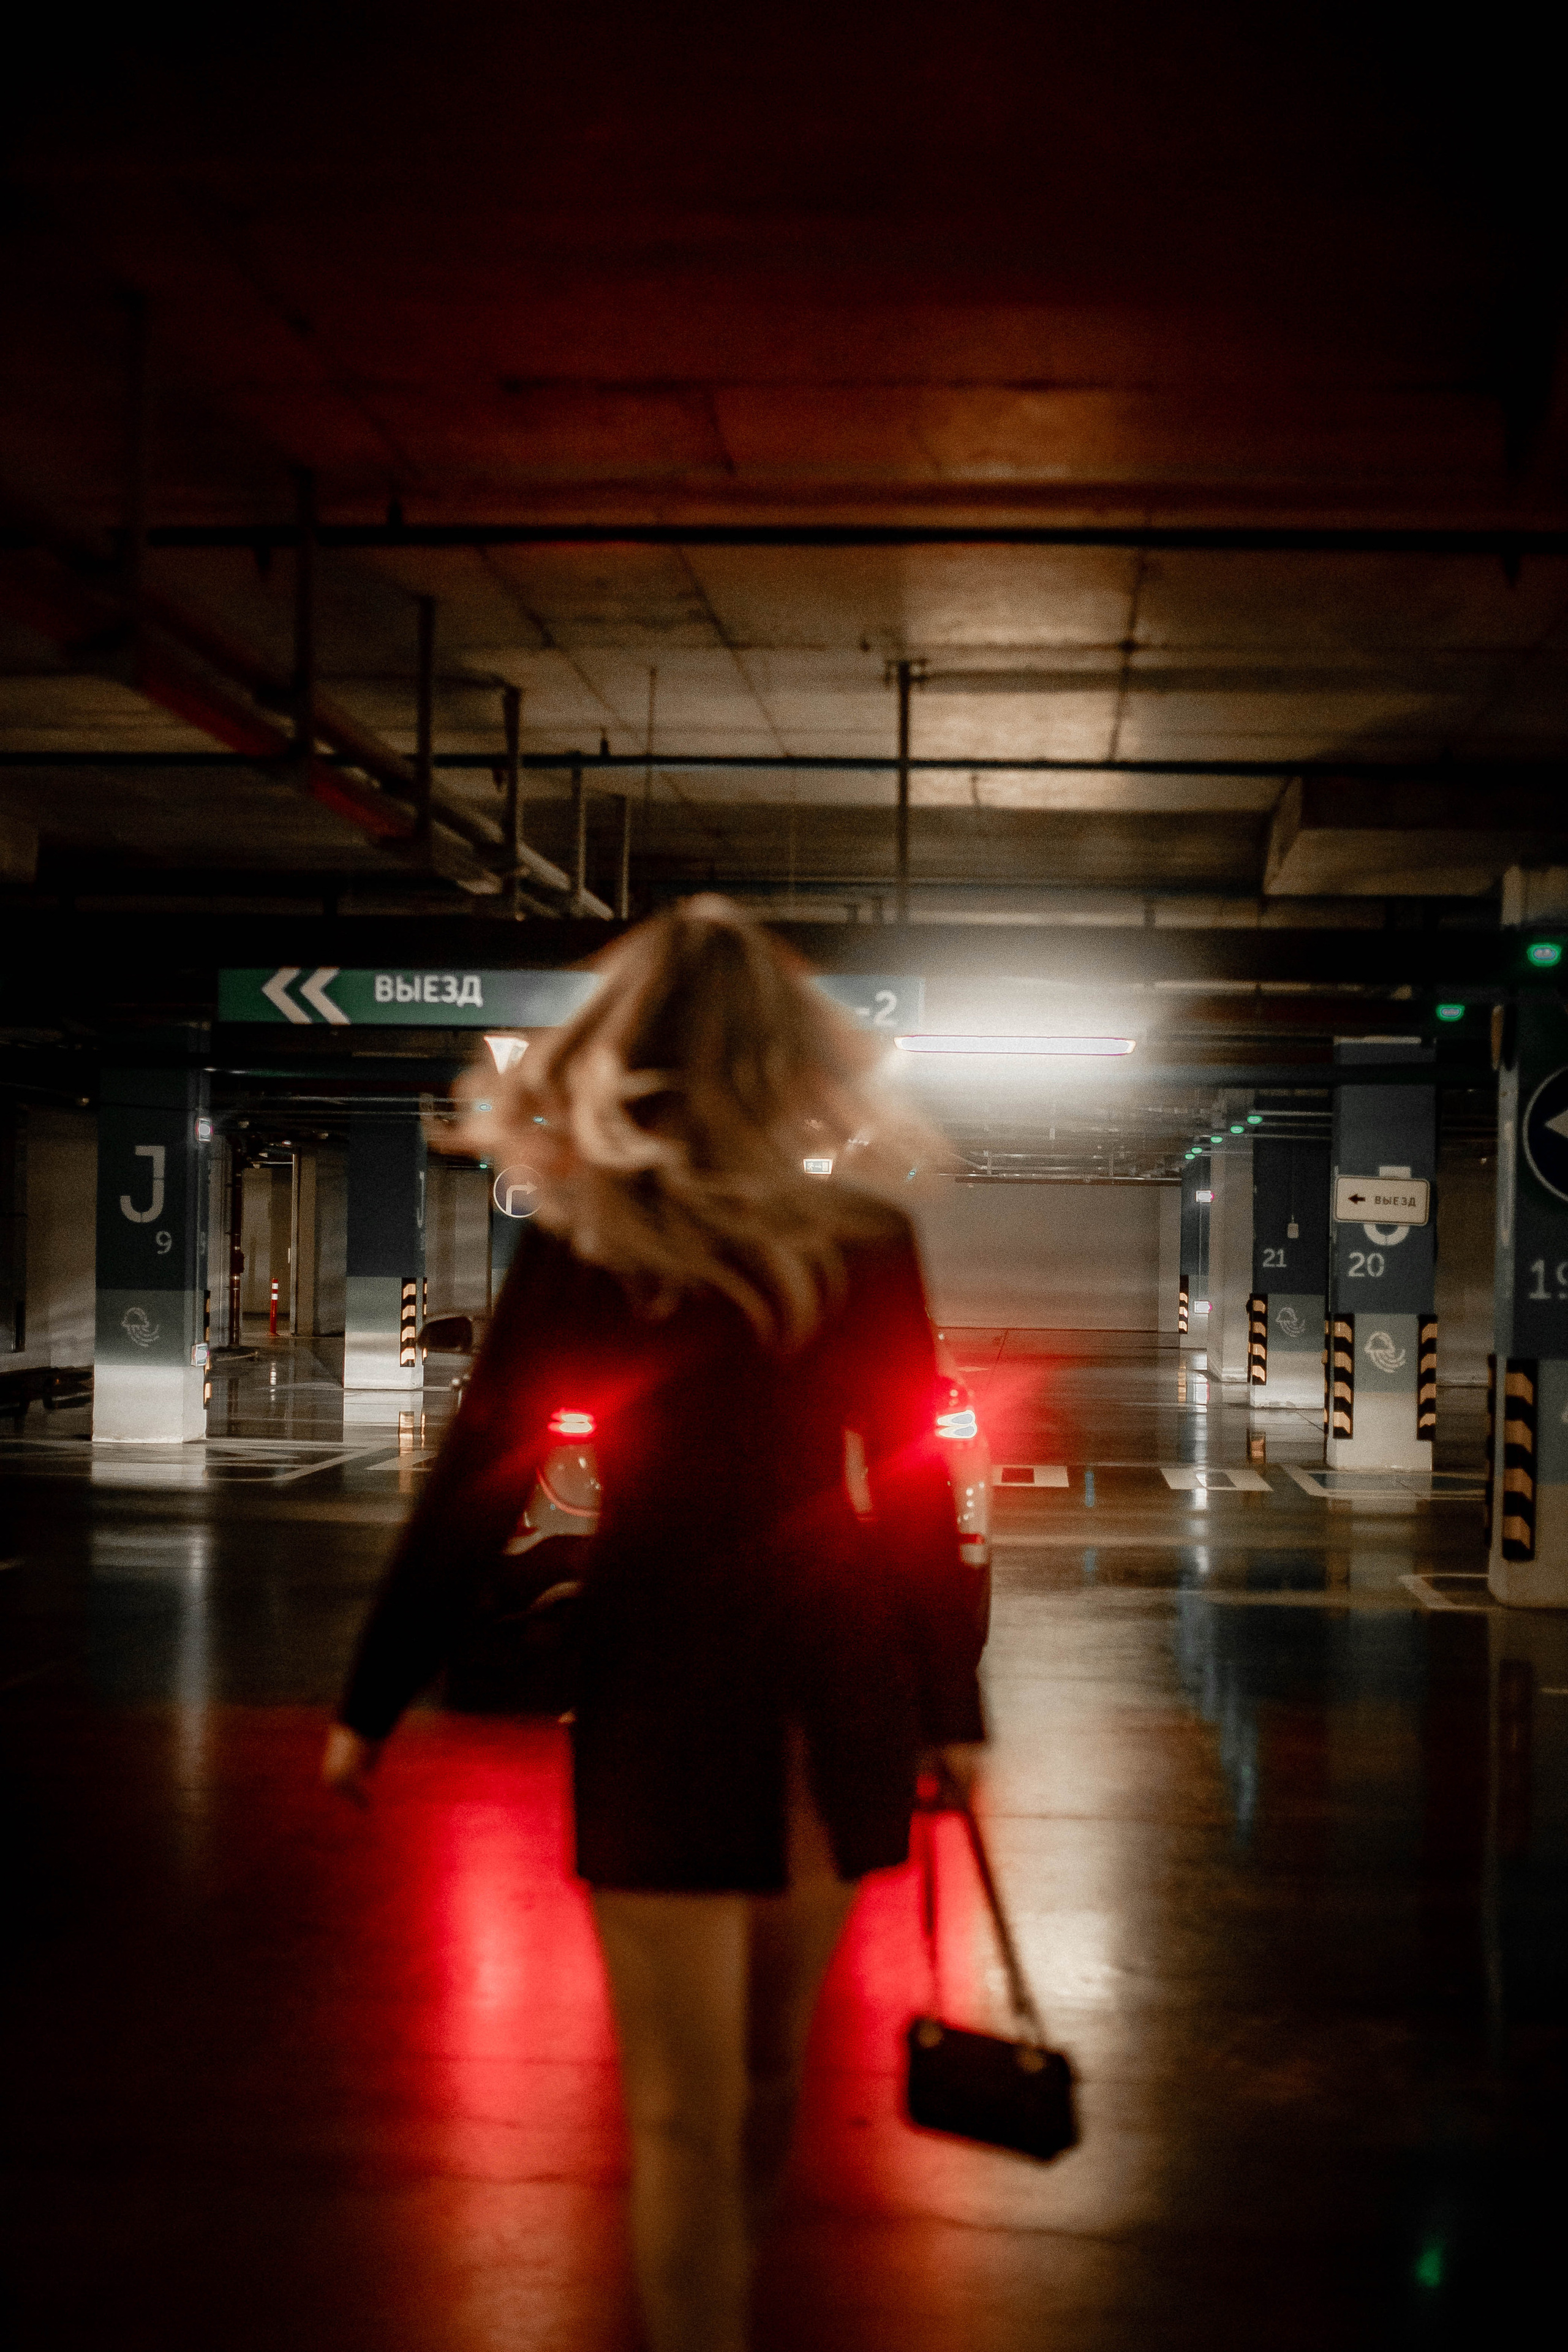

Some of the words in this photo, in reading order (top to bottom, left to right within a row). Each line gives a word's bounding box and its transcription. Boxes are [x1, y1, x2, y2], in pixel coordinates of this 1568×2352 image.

[375, 974, 483, 1008] ВЫЕЗД
[120, 1145, 165, 1223] J
[1374, 1196, 1417, 1207] ВЫЕЗД
[156, 1231, 172, 1254] 9
[1262, 1248, 1287, 1267] 21
[1348, 1252, 1384, 1277] 20
